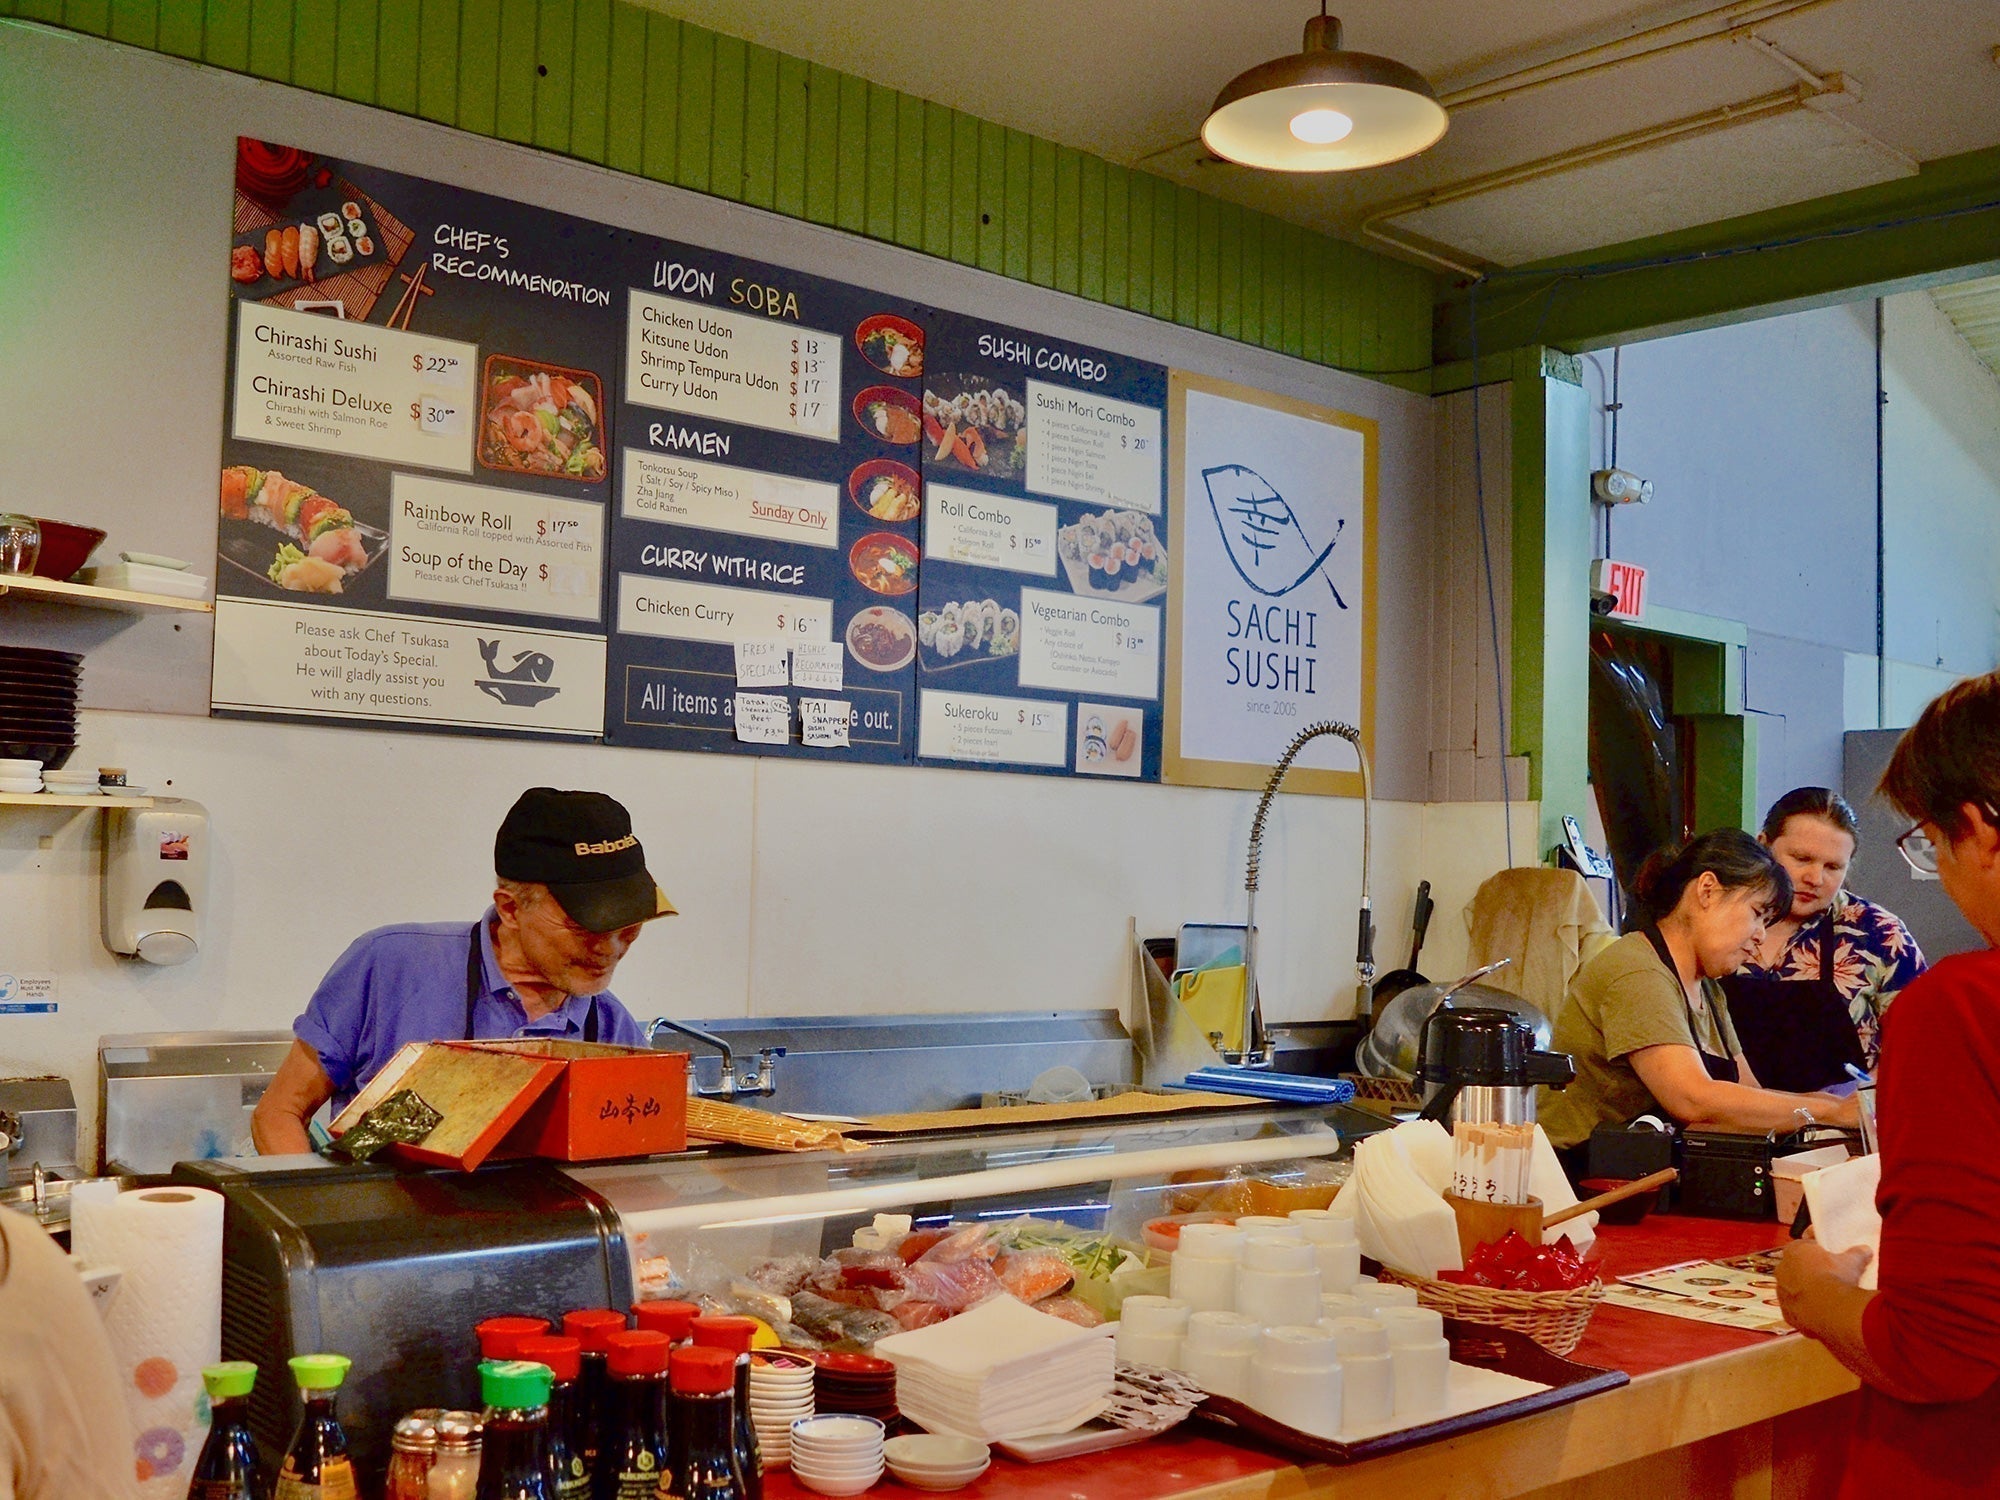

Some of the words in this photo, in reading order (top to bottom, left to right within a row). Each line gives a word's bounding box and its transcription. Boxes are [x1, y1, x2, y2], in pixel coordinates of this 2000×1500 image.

[433, 224, 510, 260] CHEF'S
[432, 253, 612, 307] RECOMMENDATION
[653, 260, 715, 298] UDON
[729, 278, 799, 320] SOBA
[642, 306, 694, 331] Chicken
[698, 317, 733, 339] Udon
[255, 325, 328, 353] Chirashi
[334, 339, 377, 362] Sushi
[642, 328, 690, 351] Kitsune
[694, 340, 728, 360] Udon
[978, 334, 1030, 366] SUSHI
[1035, 348, 1108, 382] COMBO
[268, 349, 312, 365] Assorted
[316, 357, 336, 369] Raw
[339, 361, 357, 372] Fish
[640, 350, 685, 376] Shrimp
[688, 360, 741, 384] Tempura
[745, 372, 779, 392] Udon
[252, 376, 325, 403] Chirashi
[332, 389, 392, 414] Deluxe
[640, 372, 679, 397] Curry
[683, 382, 718, 401] Udon
[266, 400, 306, 415] Chirashi
[308, 407, 329, 420] with
[332, 410, 367, 425] Salmon
[369, 417, 388, 429] Roe
[1036, 393, 1064, 412] Sushi
[1068, 401, 1094, 419] Mori
[1096, 407, 1136, 428] Combo
[264, 415, 272, 425] &
[276, 417, 304, 431] Sweet
[308, 421, 342, 438] Shrimp
[650, 423, 730, 457] RAMEN
[638, 460, 676, 475] Tonkotsu
[678, 467, 698, 480] Soup
[637, 486, 652, 496] Zha
[655, 489, 674, 502] Jiang
[646, 475, 661, 484] Salt
[669, 479, 683, 491] Soy
[692, 482, 712, 496] Spicy
[714, 487, 733, 497] Miso
[404, 500, 475, 525] Rainbow
[481, 511, 512, 531] Roll
[637, 499, 656, 510] Cold
[660, 502, 687, 514] Ramen
[752, 500, 794, 524] Sunday
[798, 508, 828, 529] Only
[941, 500, 964, 517] Roll
[968, 505, 1011, 525] Combo
[417, 520, 460, 535] California
[462, 526, 480, 538] Roll
[482, 530, 513, 543] topped
[515, 534, 534, 545] with
[535, 536, 574, 550] Assorted
[576, 541, 592, 552] Fish
[401, 545, 442, 570] Soup
[447, 553, 464, 568] of
[468, 555, 493, 572] the
[499, 558, 528, 581] Day
[641, 544, 708, 572] CURRY
[712, 554, 756, 580] WITH
[760, 561, 805, 585] RICE
[415, 570, 443, 583] Please
[444, 575, 460, 584] ask
[462, 576, 484, 587] Chef
[485, 578, 519, 591] Tsukasa
[1610, 563, 1644, 616] EXIT
[635, 597, 690, 617] Chicken
[694, 603, 734, 626] Curry
[1032, 601, 1087, 621] Vegetarian
[1090, 610, 1130, 628] Combo
[1227, 600, 1317, 649] SACHI
[295, 621, 335, 638] Please
[339, 627, 360, 640] ask
[365, 628, 396, 643] Chef
[402, 632, 449, 649] Tsukasa
[304, 644, 342, 659] about
[344, 647, 389, 666] Today's
[393, 651, 438, 668] Special.
[743, 643, 775, 657] FRESH
[296, 662, 316, 677] He
[320, 666, 342, 679] will
[346, 668, 382, 684] gladly
[386, 673, 419, 685] assist
[422, 676, 445, 689] you
[1226, 647, 1316, 694] SUSHI
[310, 687, 339, 700] with
[343, 690, 366, 705] any
[369, 692, 432, 707] questions.
[641, 682, 666, 712] All
[673, 687, 717, 716] items
[864, 706, 894, 731] out.
[805, 702, 826, 713] TAI
[944, 702, 999, 721] Sukeroku
[1246, 699, 1271, 714] since
[1273, 701, 1297, 717] 2005
[812, 717, 848, 725] SNAPPER
